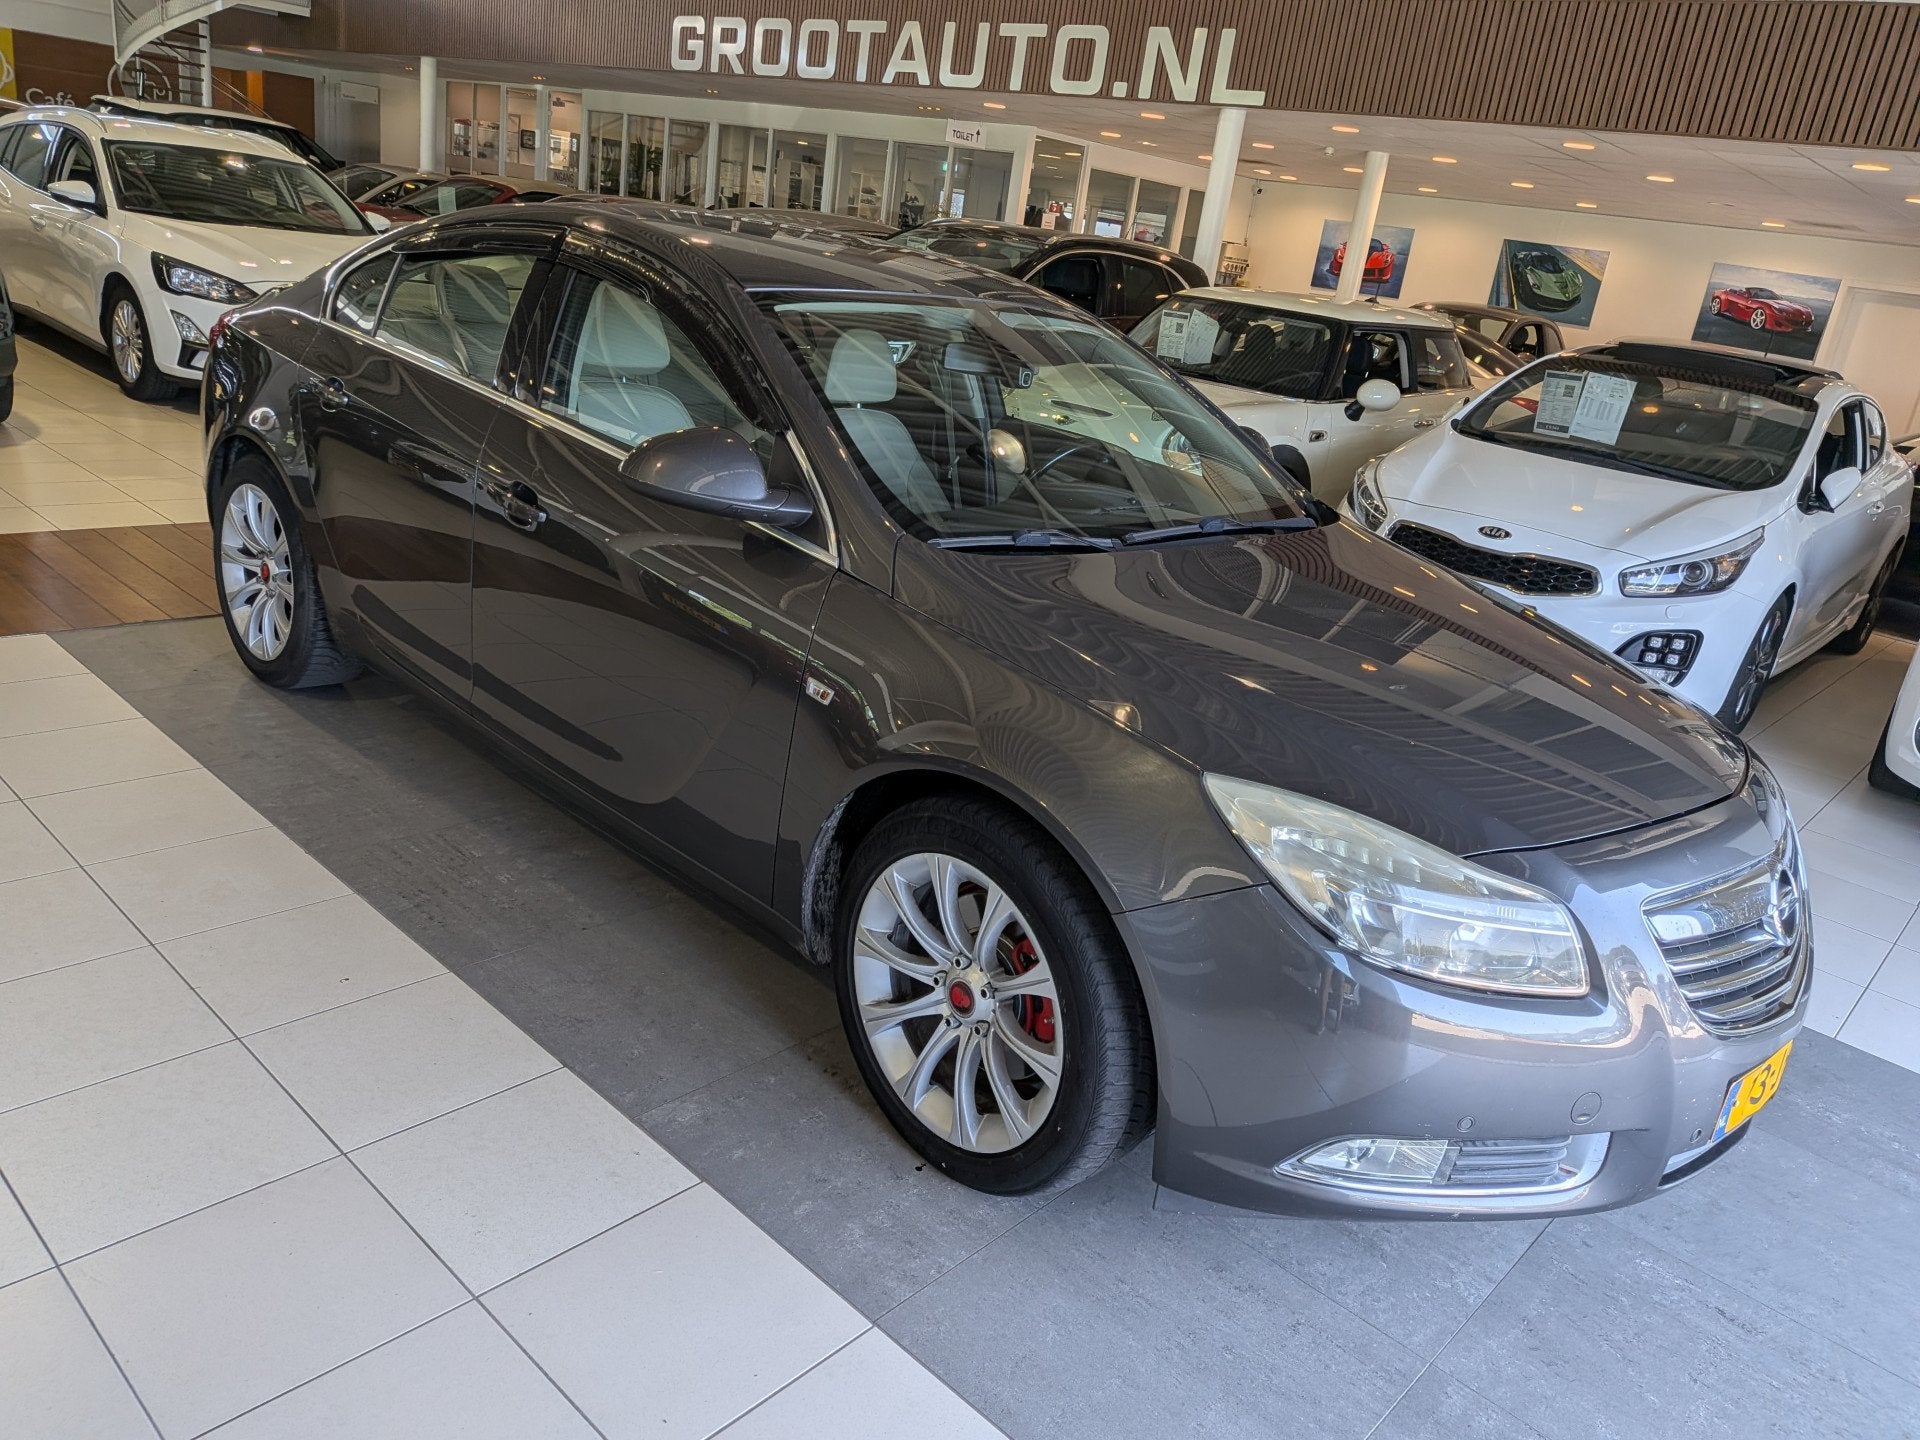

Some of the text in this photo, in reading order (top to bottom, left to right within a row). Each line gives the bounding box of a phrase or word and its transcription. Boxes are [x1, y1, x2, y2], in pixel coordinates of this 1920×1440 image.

[671, 15, 1266, 107] GROOTAUTO.NL
[952, 129, 975, 143] TOILET
[553, 170, 575, 184] INGANG
[1481, 526, 1506, 538] KIA
